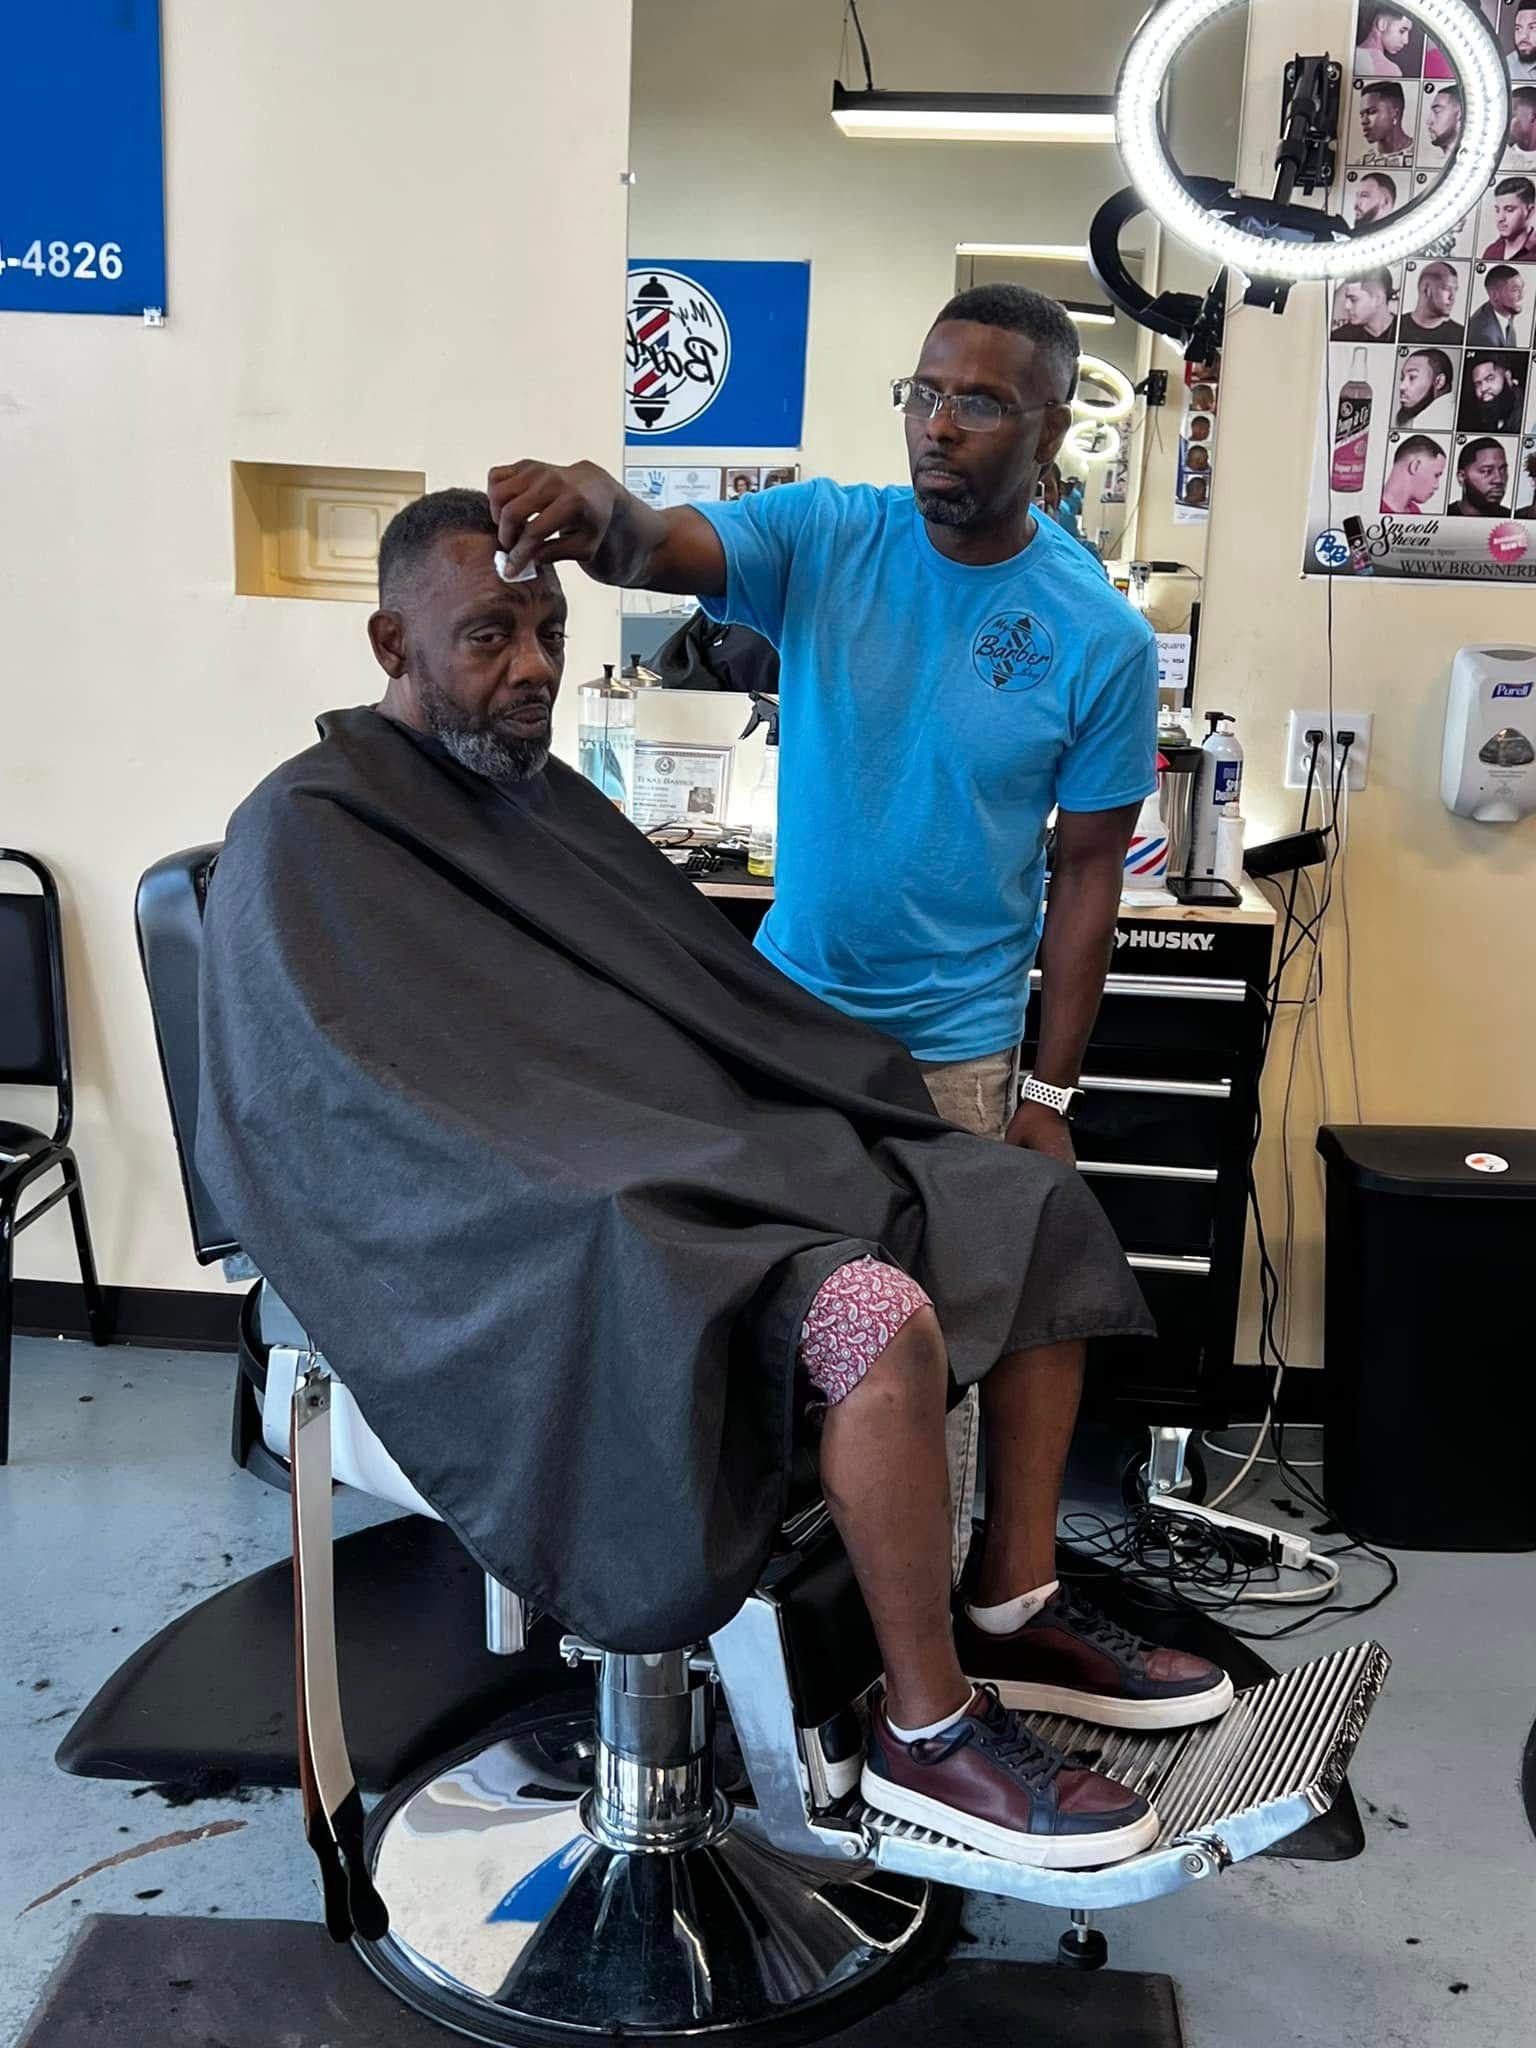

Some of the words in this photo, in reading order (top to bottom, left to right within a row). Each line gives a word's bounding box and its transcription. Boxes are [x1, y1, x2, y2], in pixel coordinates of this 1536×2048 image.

[0, 239, 123, 280] -4826
[1366, 515, 1440, 540] Smooth
[1369, 531, 1431, 557] Sheen
[976, 634, 1050, 665] Barber
